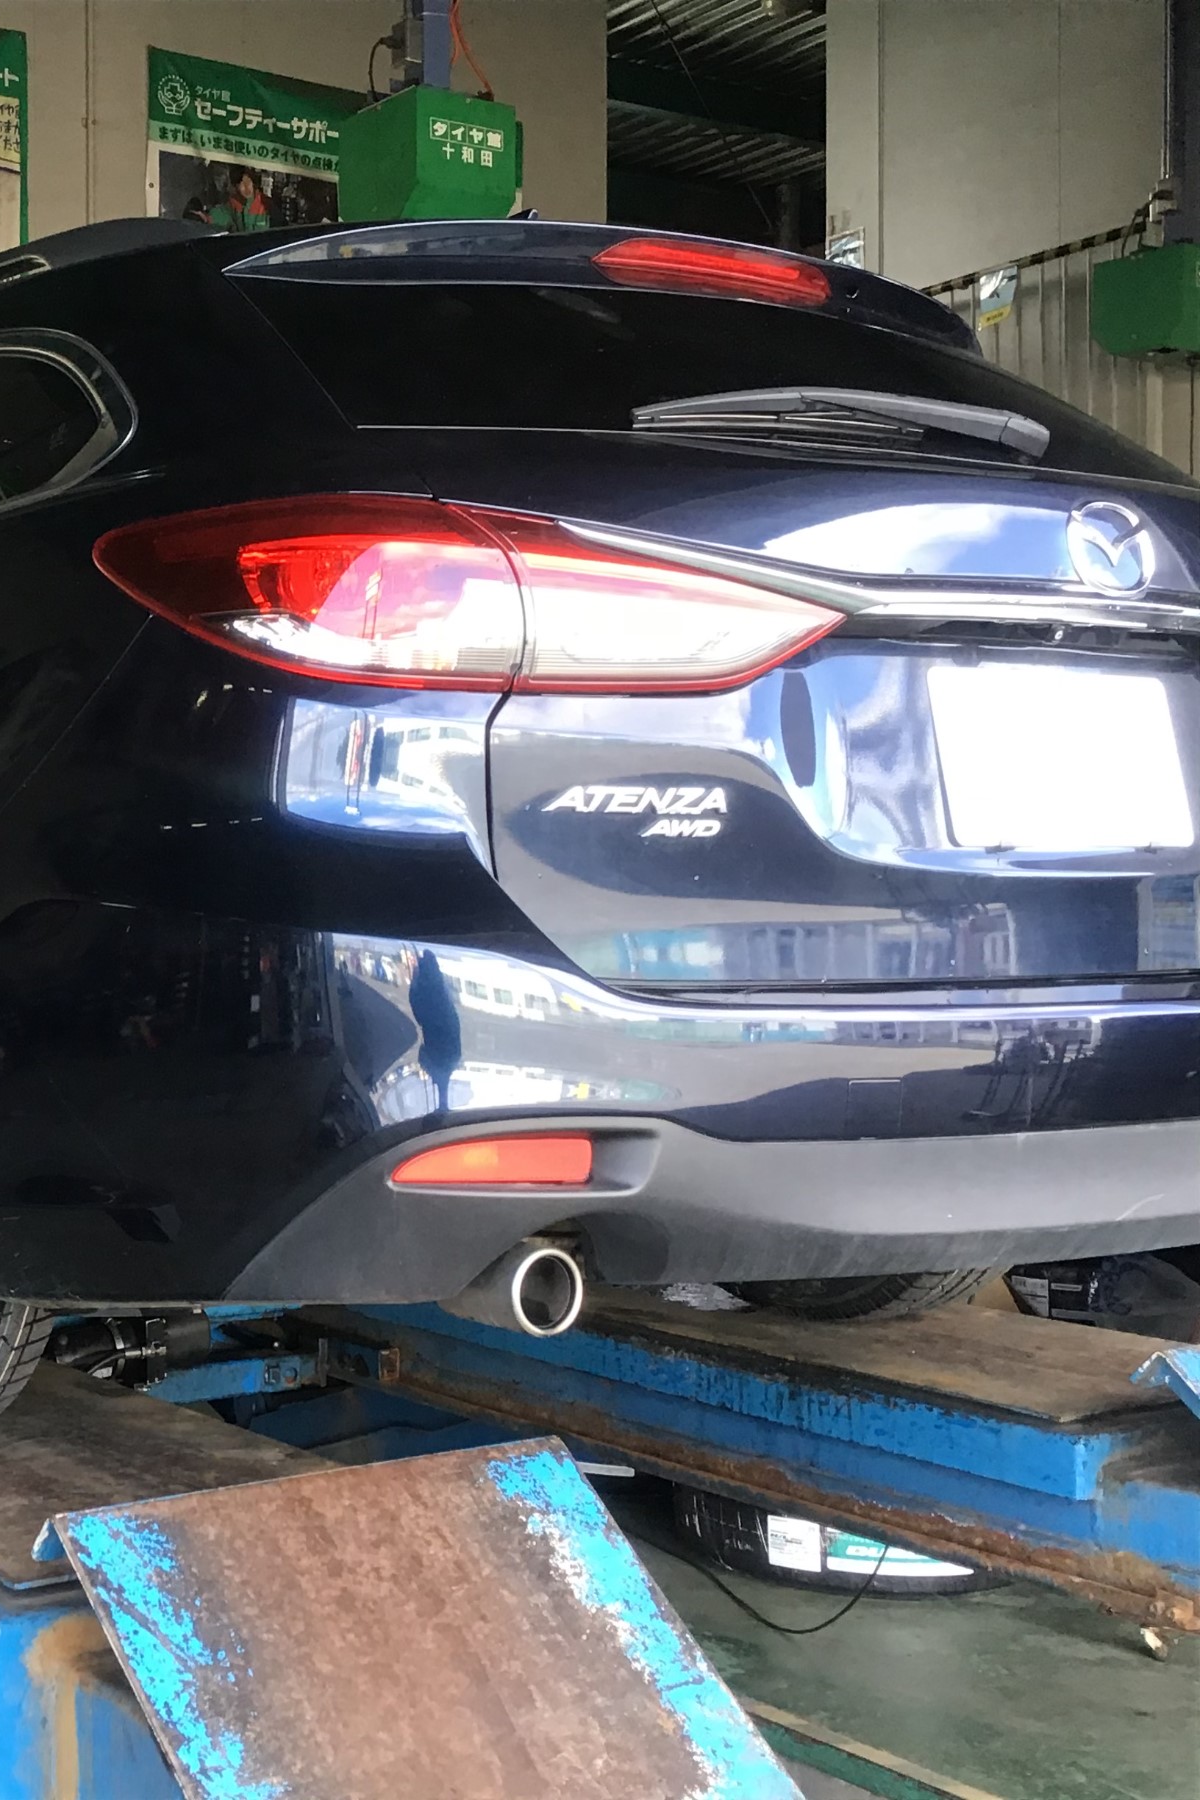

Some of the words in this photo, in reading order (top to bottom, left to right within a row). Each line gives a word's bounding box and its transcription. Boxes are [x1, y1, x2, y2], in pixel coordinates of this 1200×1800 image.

[194, 98, 340, 144] セーフティーサポー
[432, 121, 502, 149] タイヤ館
[442, 142, 493, 168] 十和田
[541, 785, 728, 814] ATENZA
[638, 819, 721, 838] AWD
